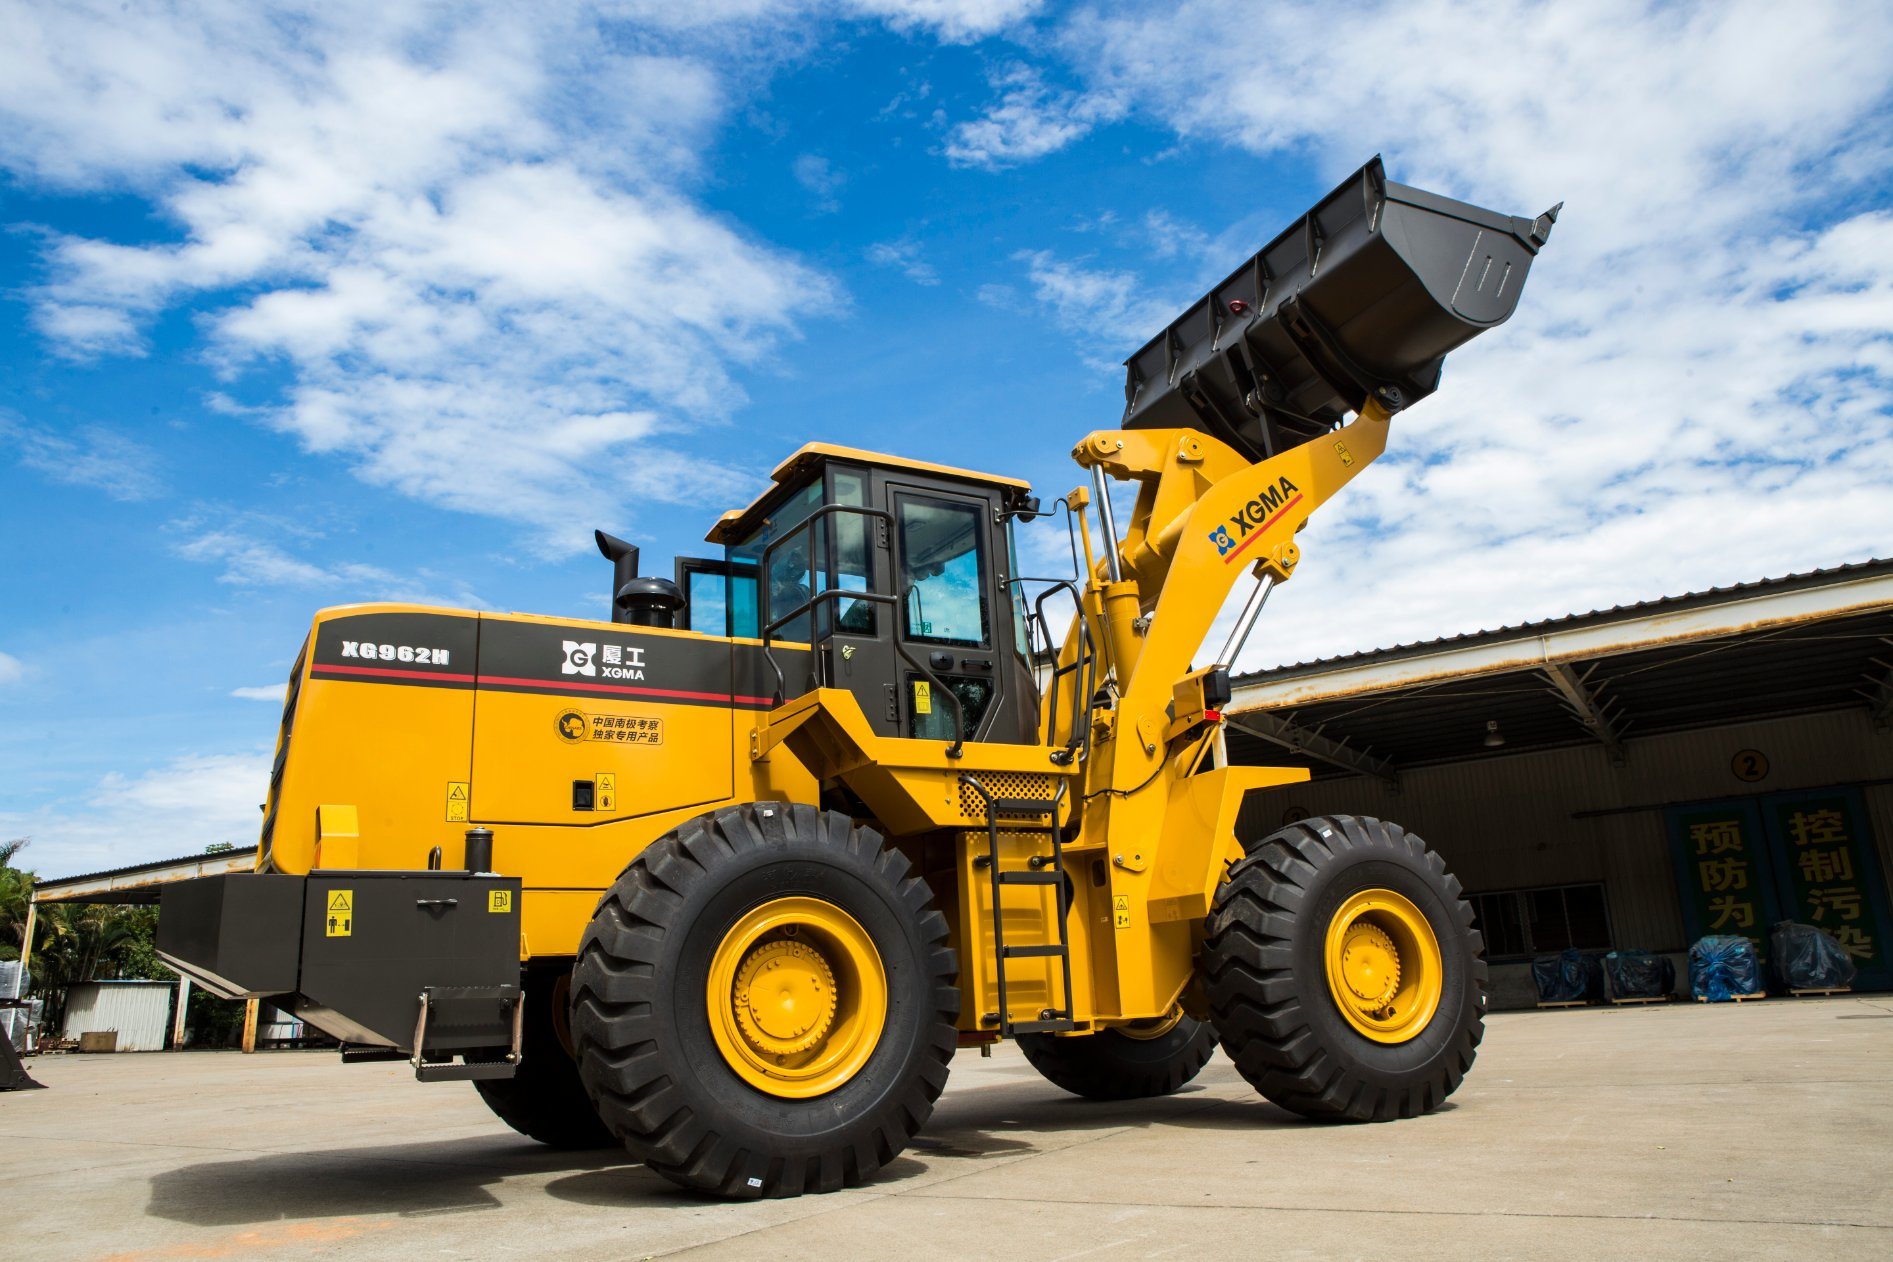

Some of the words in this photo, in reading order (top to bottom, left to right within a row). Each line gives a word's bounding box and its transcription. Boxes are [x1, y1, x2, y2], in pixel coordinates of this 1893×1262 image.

[1230, 476, 1299, 537] XGMA
[341, 641, 450, 665] XG962H
[602, 645, 645, 667] 厦工
[602, 667, 644, 680] XGMA
[592, 716, 659, 731] 中国南极考察
[592, 729, 659, 743] 独家专用产品
[1743, 756, 1759, 776] 2
[1689, 820, 1767, 964] 预防为
